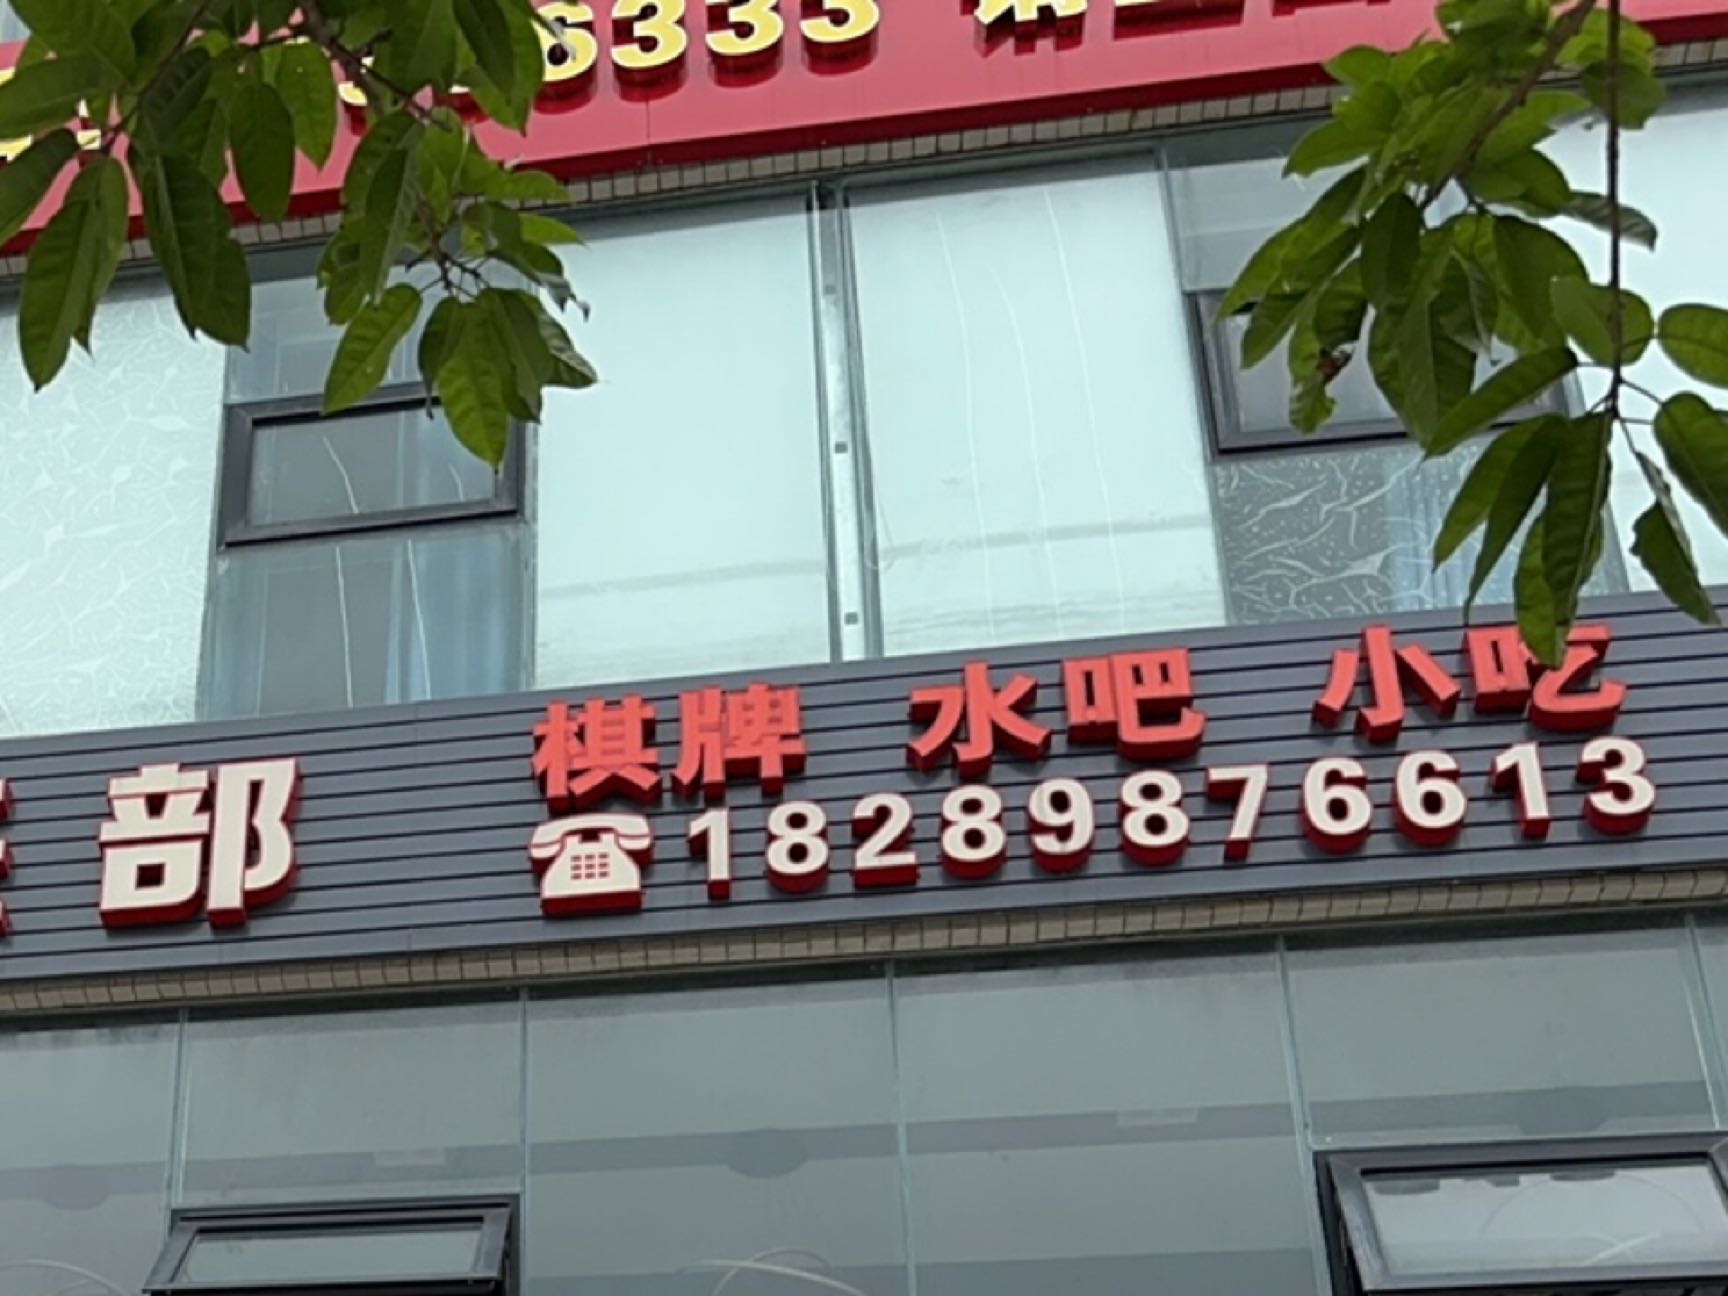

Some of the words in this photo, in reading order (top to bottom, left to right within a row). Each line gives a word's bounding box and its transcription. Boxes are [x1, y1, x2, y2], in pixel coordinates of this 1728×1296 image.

[533, 683, 808, 804] 棋牌
[907, 647, 1206, 776] 水吧
[1313, 624, 1628, 742] 小吃
[688, 735, 1656, 899] 18289876613
